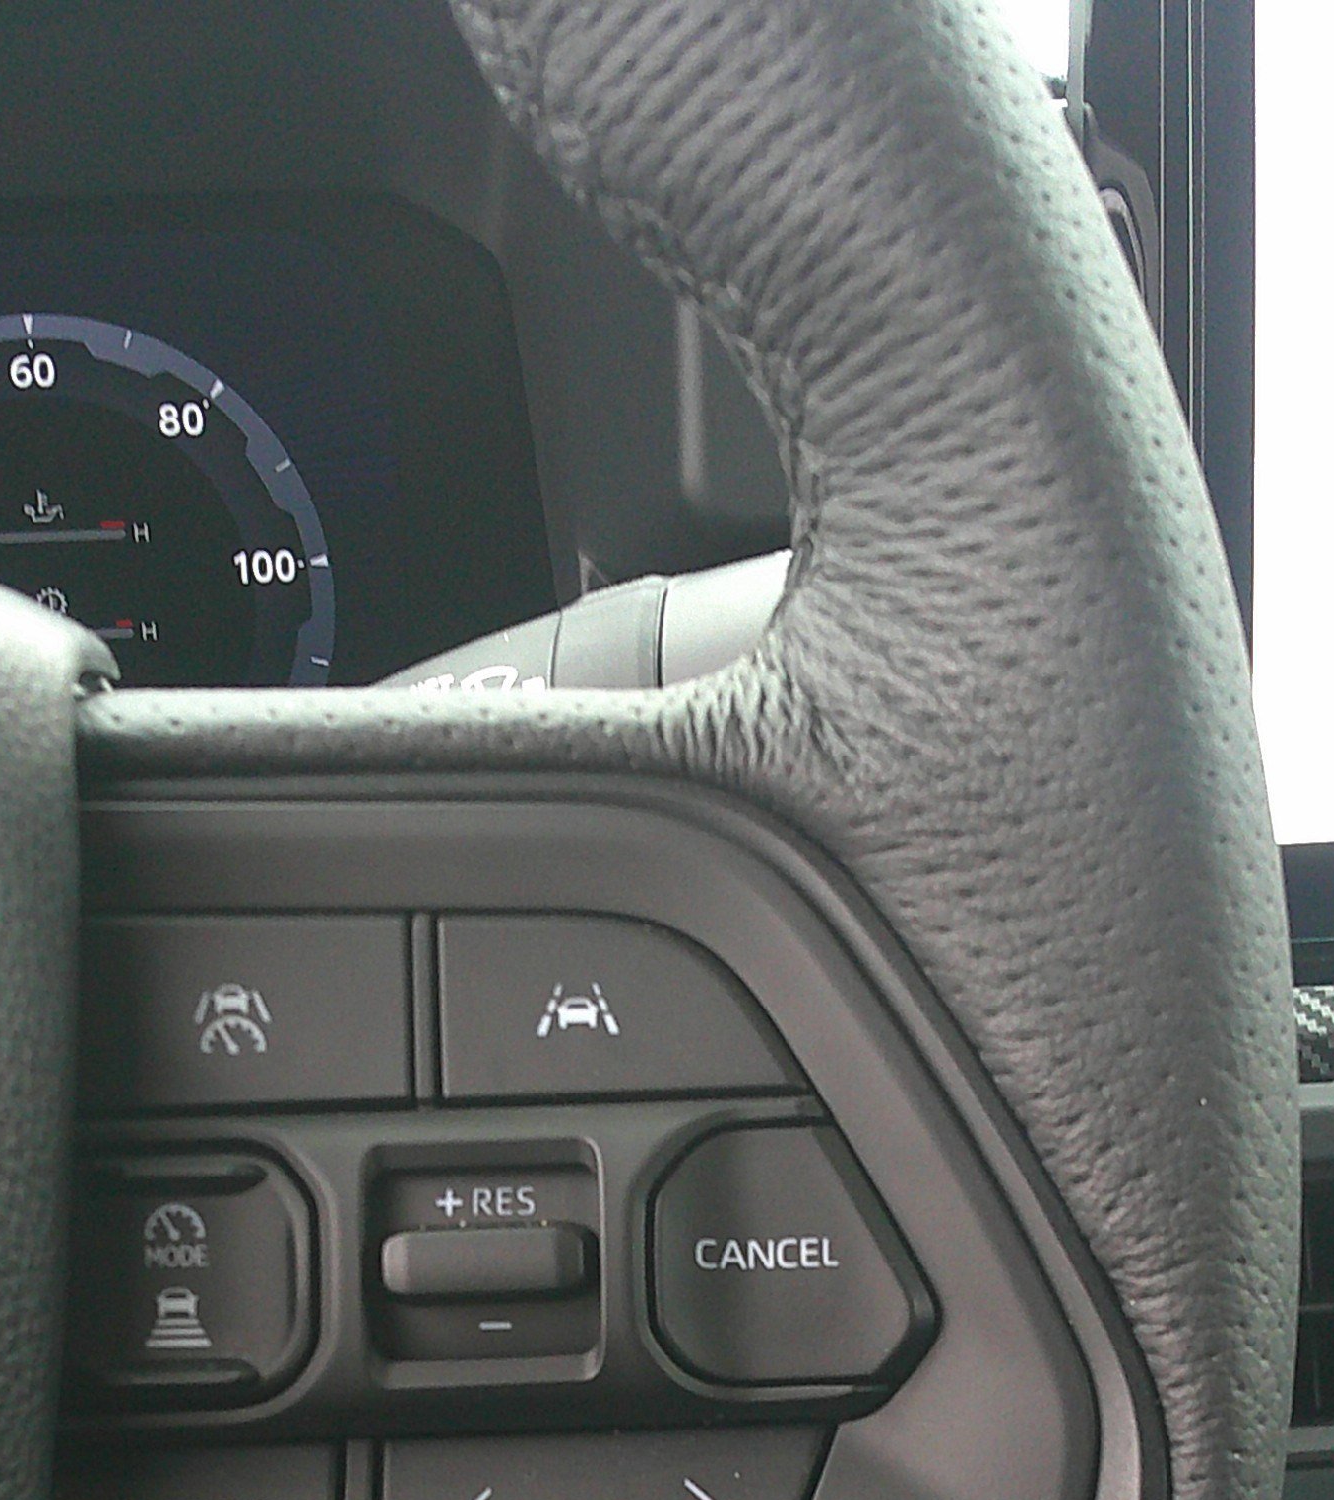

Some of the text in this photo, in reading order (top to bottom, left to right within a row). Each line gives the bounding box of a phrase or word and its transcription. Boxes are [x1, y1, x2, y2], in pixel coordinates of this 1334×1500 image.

[10, 354, 55, 389] 60
[158, 404, 204, 436] 80
[132, 522, 151, 544] H
[233, 550, 296, 585] 100
[140, 622, 158, 641] H
[145, 1244, 209, 1269] MODE
[694, 1237, 839, 1271] CANCEL
